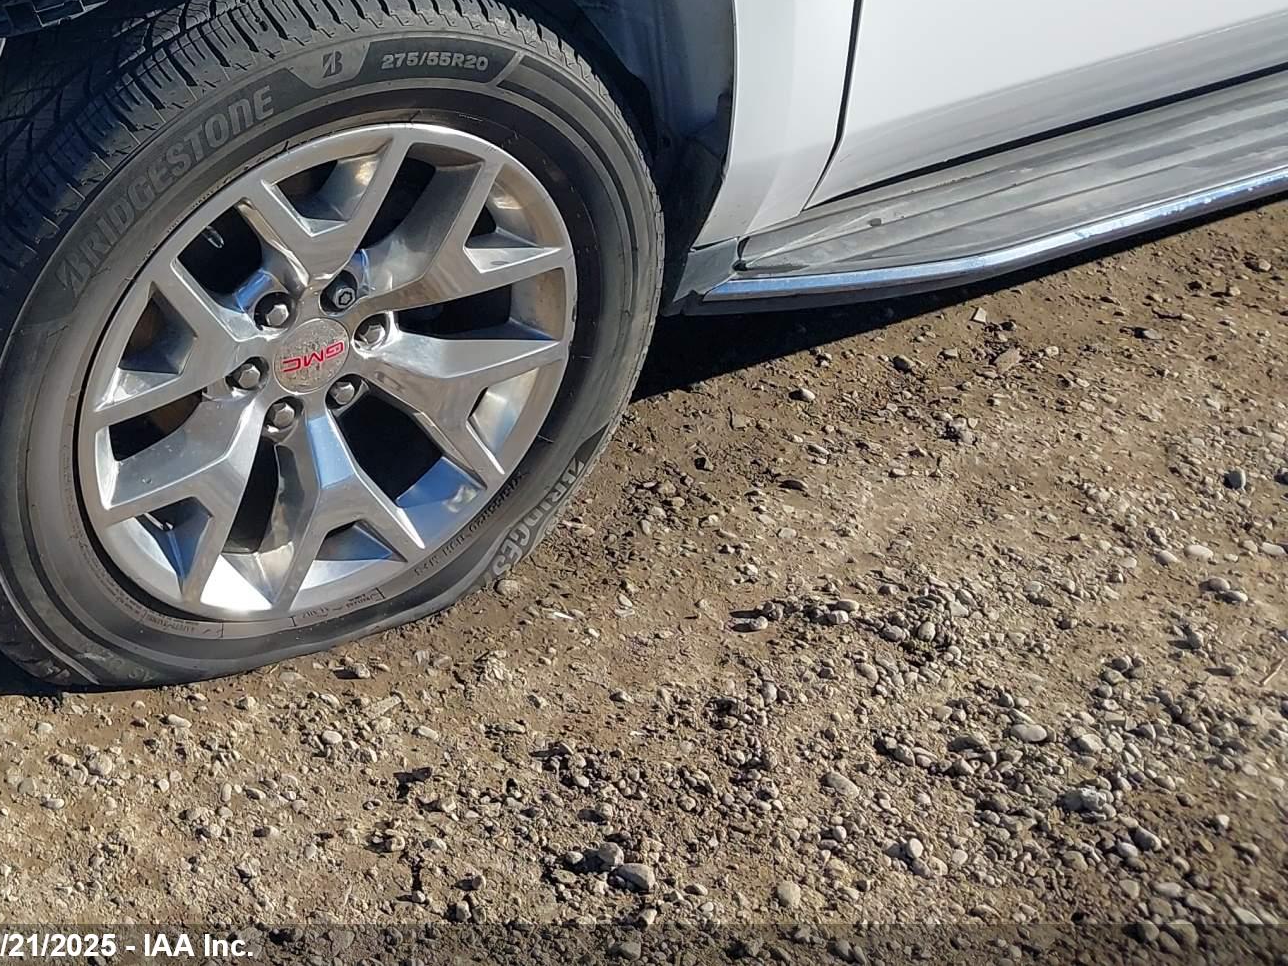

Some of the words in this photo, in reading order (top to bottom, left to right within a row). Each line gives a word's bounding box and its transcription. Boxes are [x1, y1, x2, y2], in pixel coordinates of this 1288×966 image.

[55, 84, 274, 301] BRIDGESTONE
[381, 51, 490, 74] 275/55R20
[281, 340, 345, 373] GMC
